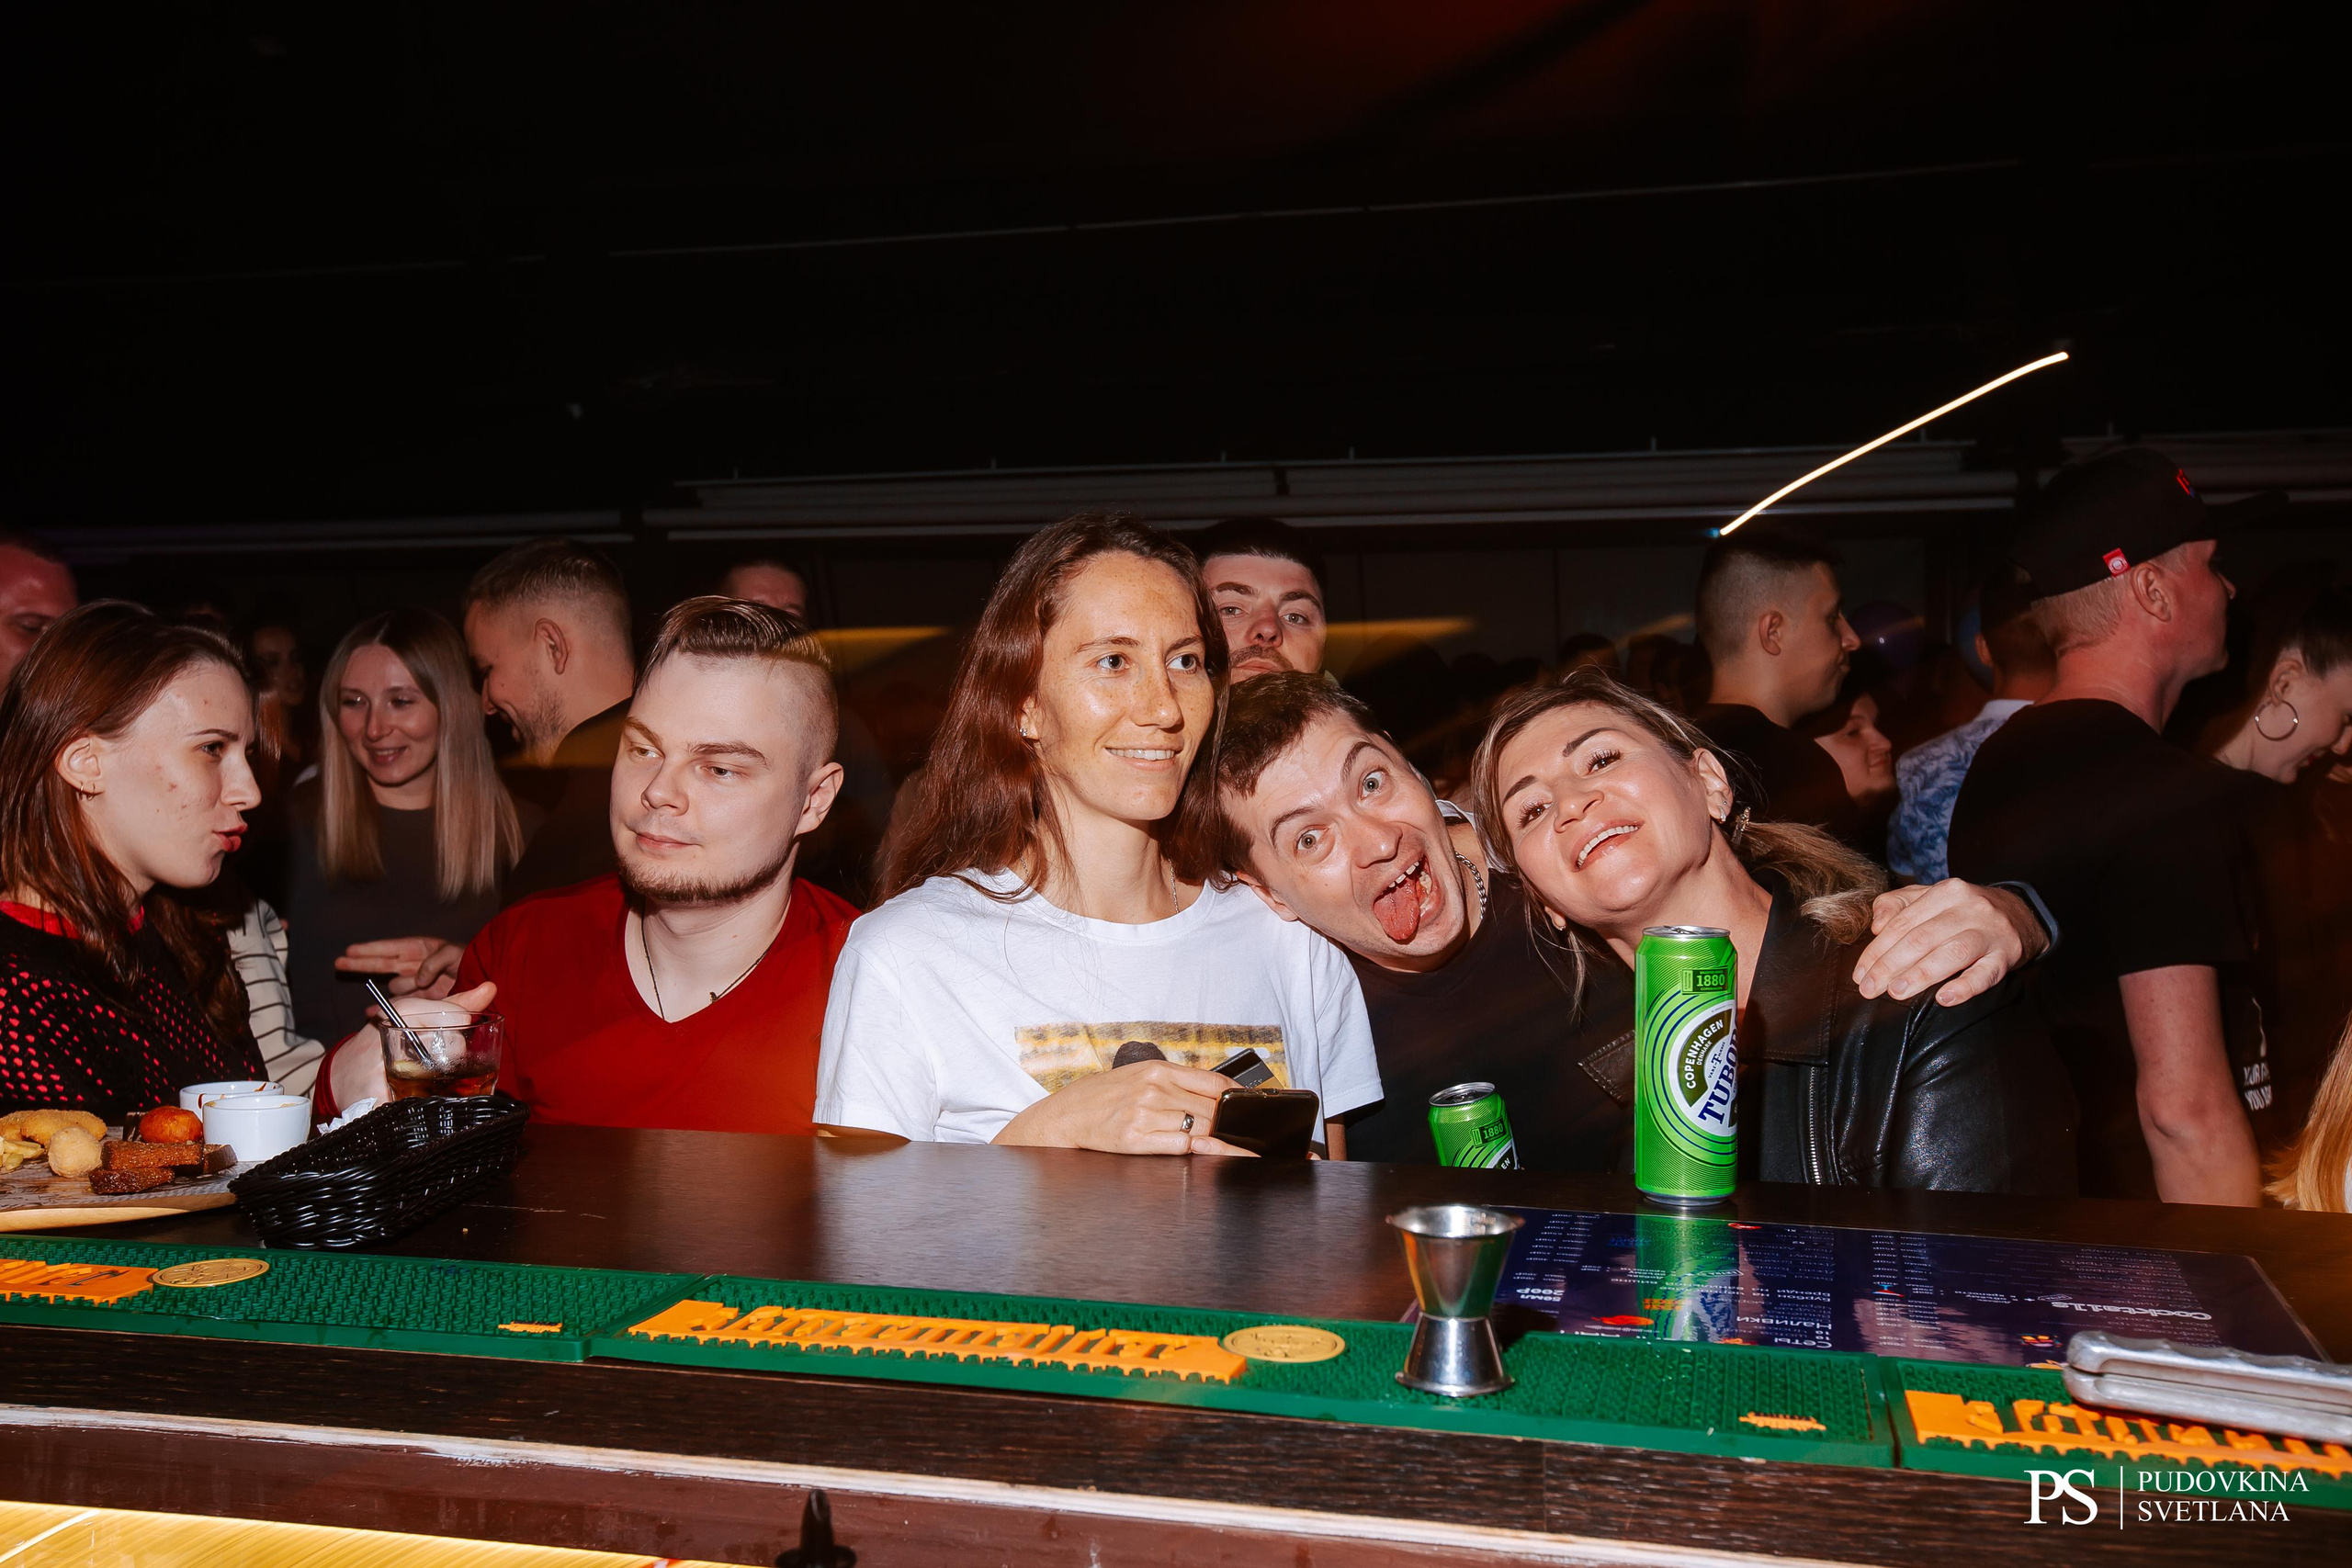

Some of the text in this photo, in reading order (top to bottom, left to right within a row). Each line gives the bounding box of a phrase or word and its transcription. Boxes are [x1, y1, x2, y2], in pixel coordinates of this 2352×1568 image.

[1696, 974, 1725, 987] 1880
[1684, 1019, 1724, 1089] COPENHAGEN
[1696, 1040, 1713, 1066] DENMARK
[1697, 1027, 1738, 1124] TUBOR
[1483, 1122, 1504, 1140] 1880
[2051, 1302, 2212, 1320] Cocktails
[1736, 1316, 1832, 1330] Наливки
[1774, 1337, 1832, 1348] Сеты
